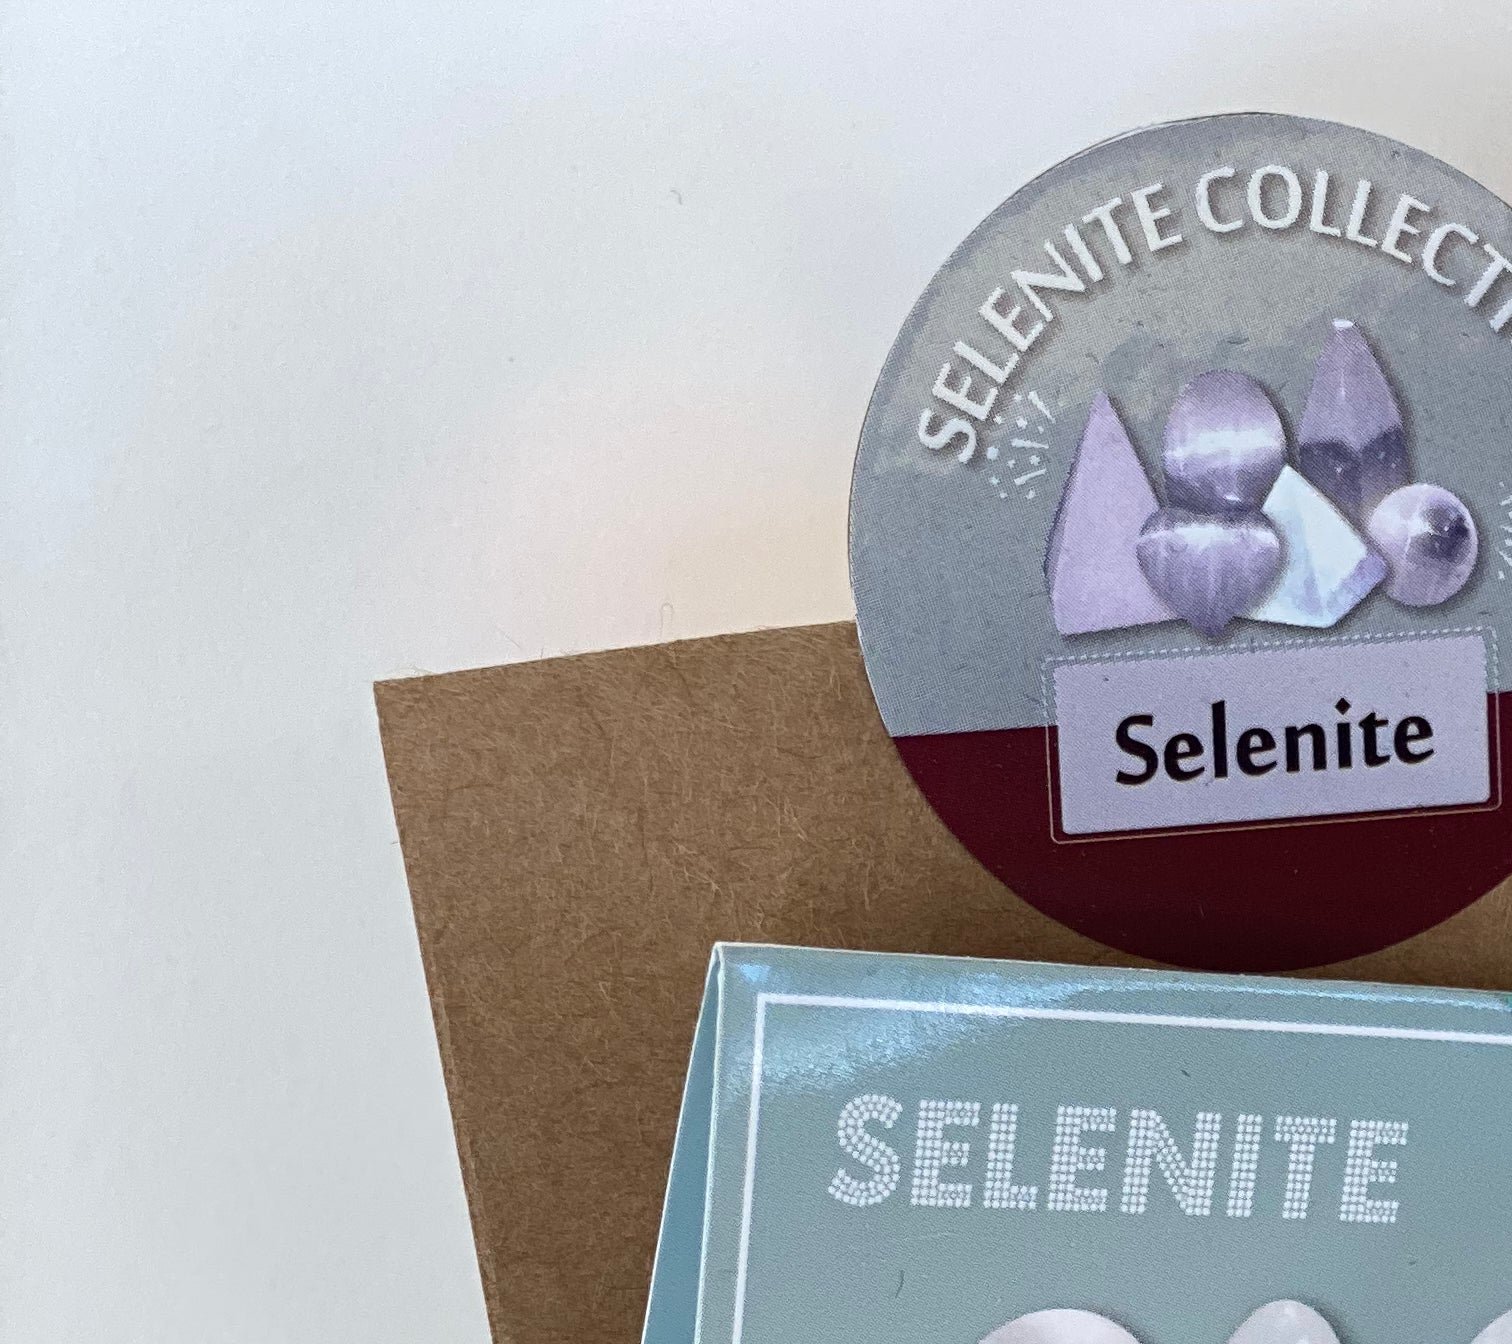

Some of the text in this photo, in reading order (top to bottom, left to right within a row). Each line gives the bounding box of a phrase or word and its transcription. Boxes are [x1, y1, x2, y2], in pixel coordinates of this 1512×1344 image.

[918, 182, 1182, 463] SELENITE
[1115, 698, 1436, 787] Selenite
[828, 1093, 1409, 1223] SELENITE
